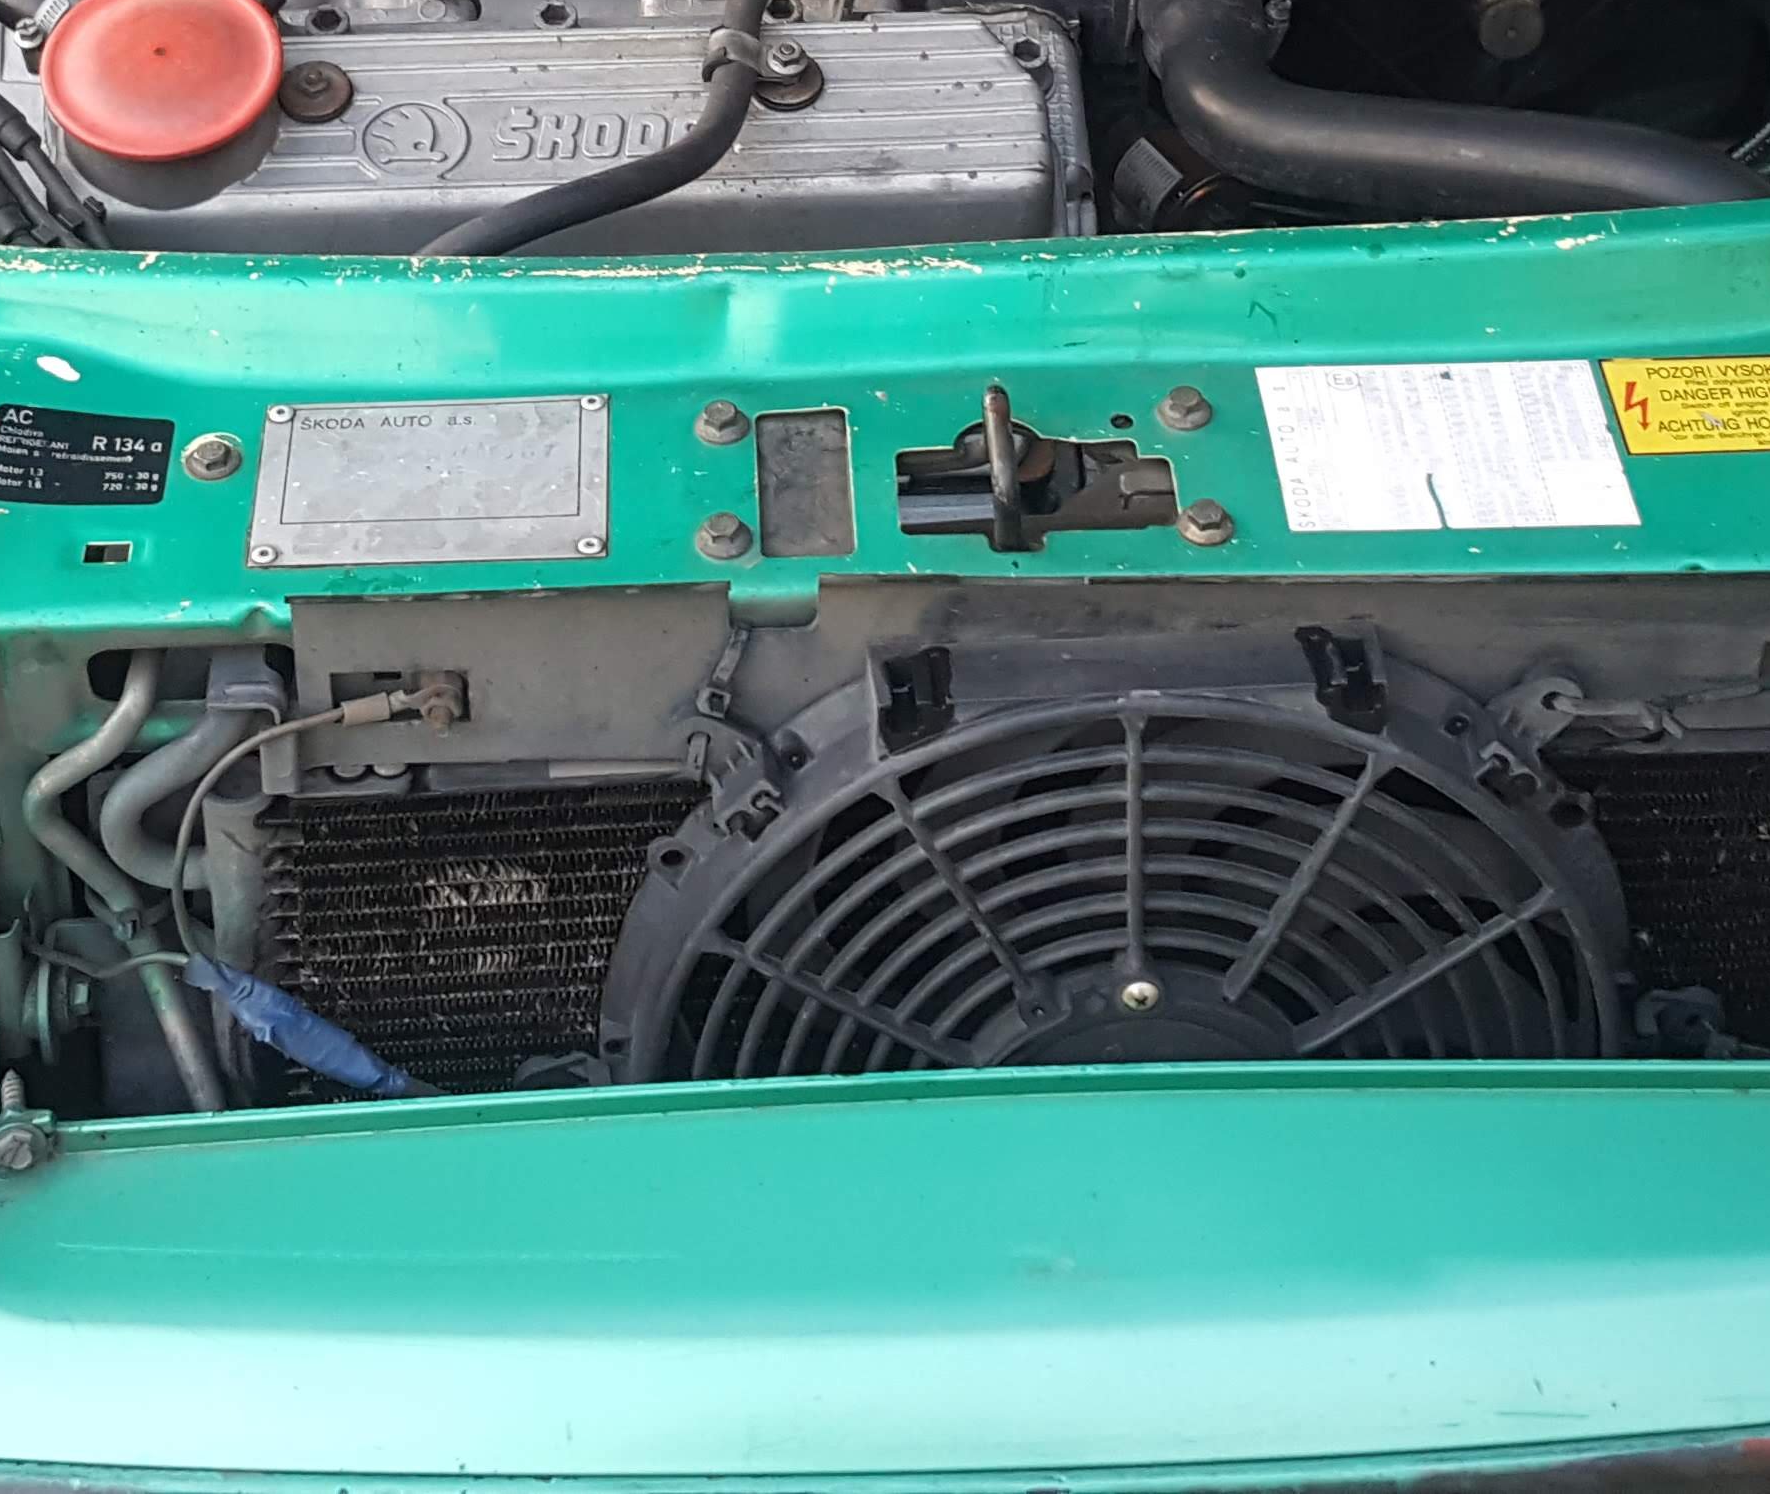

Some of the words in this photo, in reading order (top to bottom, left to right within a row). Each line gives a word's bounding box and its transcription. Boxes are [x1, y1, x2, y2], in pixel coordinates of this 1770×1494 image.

[1645, 365, 1713, 380] POZOR!
[1659, 387, 1734, 402] DANGER
[2, 408, 34, 425] AC
[300, 416, 366, 431] ŠKODA
[379, 414, 433, 429] AUTO
[92, 435, 108, 452] R
[114, 437, 146, 453] 134
[150, 441, 163, 453] a
